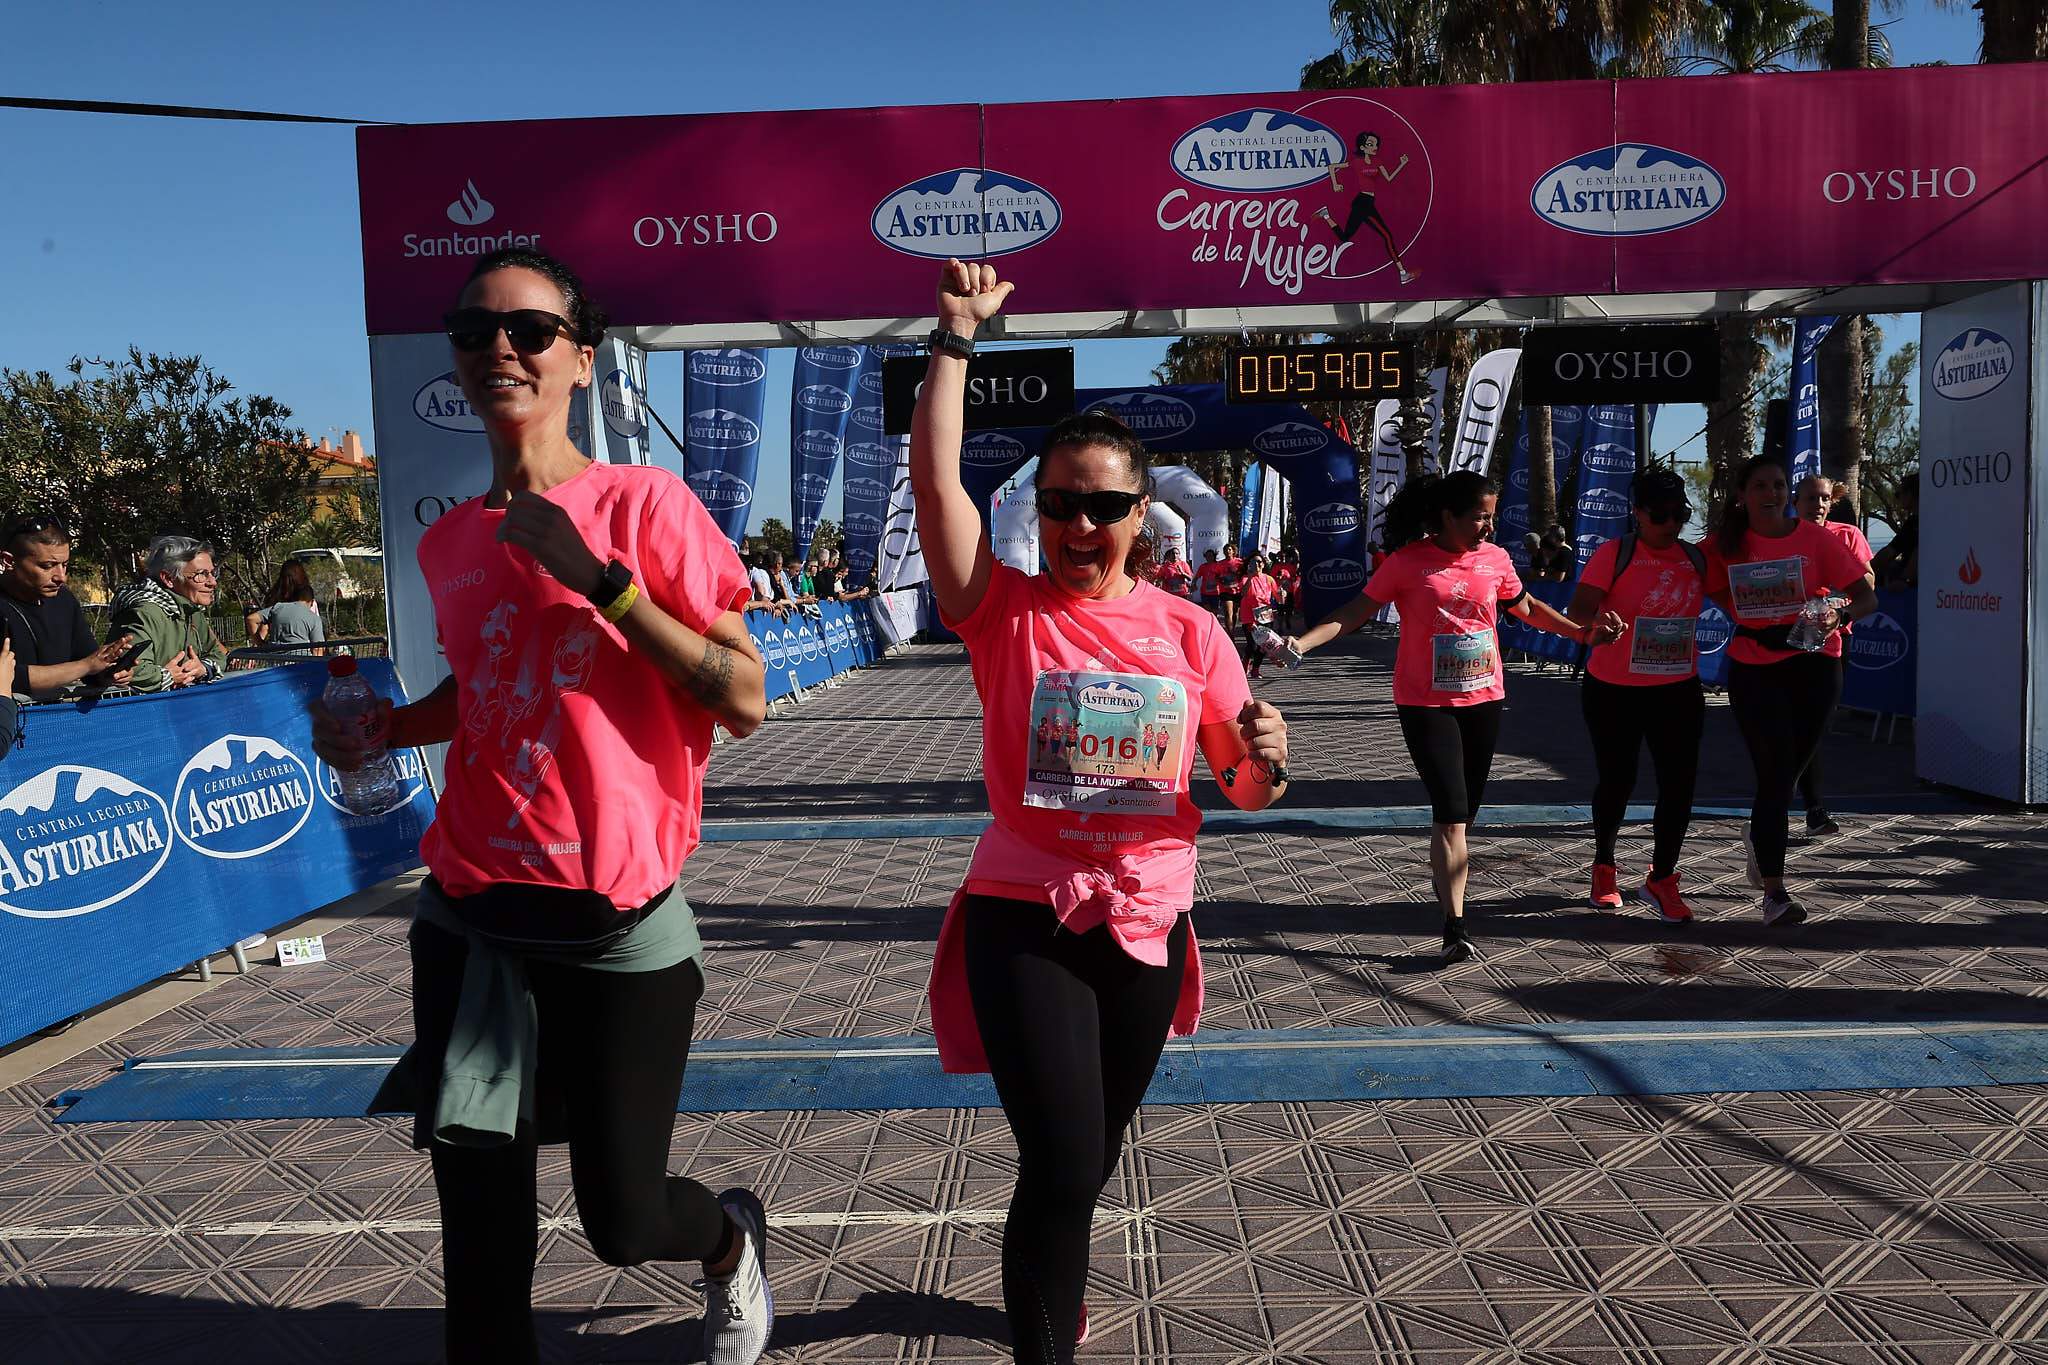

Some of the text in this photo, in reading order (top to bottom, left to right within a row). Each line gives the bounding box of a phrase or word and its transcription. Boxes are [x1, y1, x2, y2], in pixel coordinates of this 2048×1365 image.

[1211, 134, 1327, 147] CENTRAL LECHERA
[1184, 140, 1331, 172] ASTURIANA
[1576, 172, 1704, 186] CENTRAL LECHERA
[1822, 166, 1976, 203] OYSHO
[915, 200, 974, 211] CENTRAL
[1157, 188, 1300, 231] Carrera
[1546, 179, 1710, 214] ASTURIANA
[633, 211, 778, 248] OYSHO
[886, 204, 1047, 239] ASTURIANA
[403, 229, 541, 258] Santander
[1192, 223, 1354, 295] de la Mujer
[690, 358, 758, 378] ASTURIANA
[807, 347, 856, 365] ASTURIANA
[1554, 349, 1692, 381] OYSHO
[1239, 350, 1401, 394] 00:59:05
[1937, 356, 2008, 388] ASTURIANA
[802, 391, 848, 409] ASTURIANA
[914, 375, 1047, 405] SHO
[687, 422, 753, 441] ASTURIANA
[1260, 435, 1323, 449] ASTURIANA
[1931, 451, 2011, 488] OYSHO
[1936, 588, 2002, 612] Santander
[1082, 690, 1140, 708] ASTURIANA
[1080, 733, 1138, 759] 016
[204, 762, 296, 794] CENTRAL LECHERA
[1035, 771, 1169, 790] CARRERA DE LA MUJER VALENCIA
[1095, 764, 1115, 775] 173
[187, 778, 308, 839] ASTURIANA
[1042, 788, 1161, 809] OYSHO Santander
[16, 798, 151, 841] CENTRAL LECHERA
[548, 841, 581, 855] MUJER
[1059, 828, 1144, 842] CARRERA DE LA MUJER
[0, 816, 165, 896] ASTURIANA
